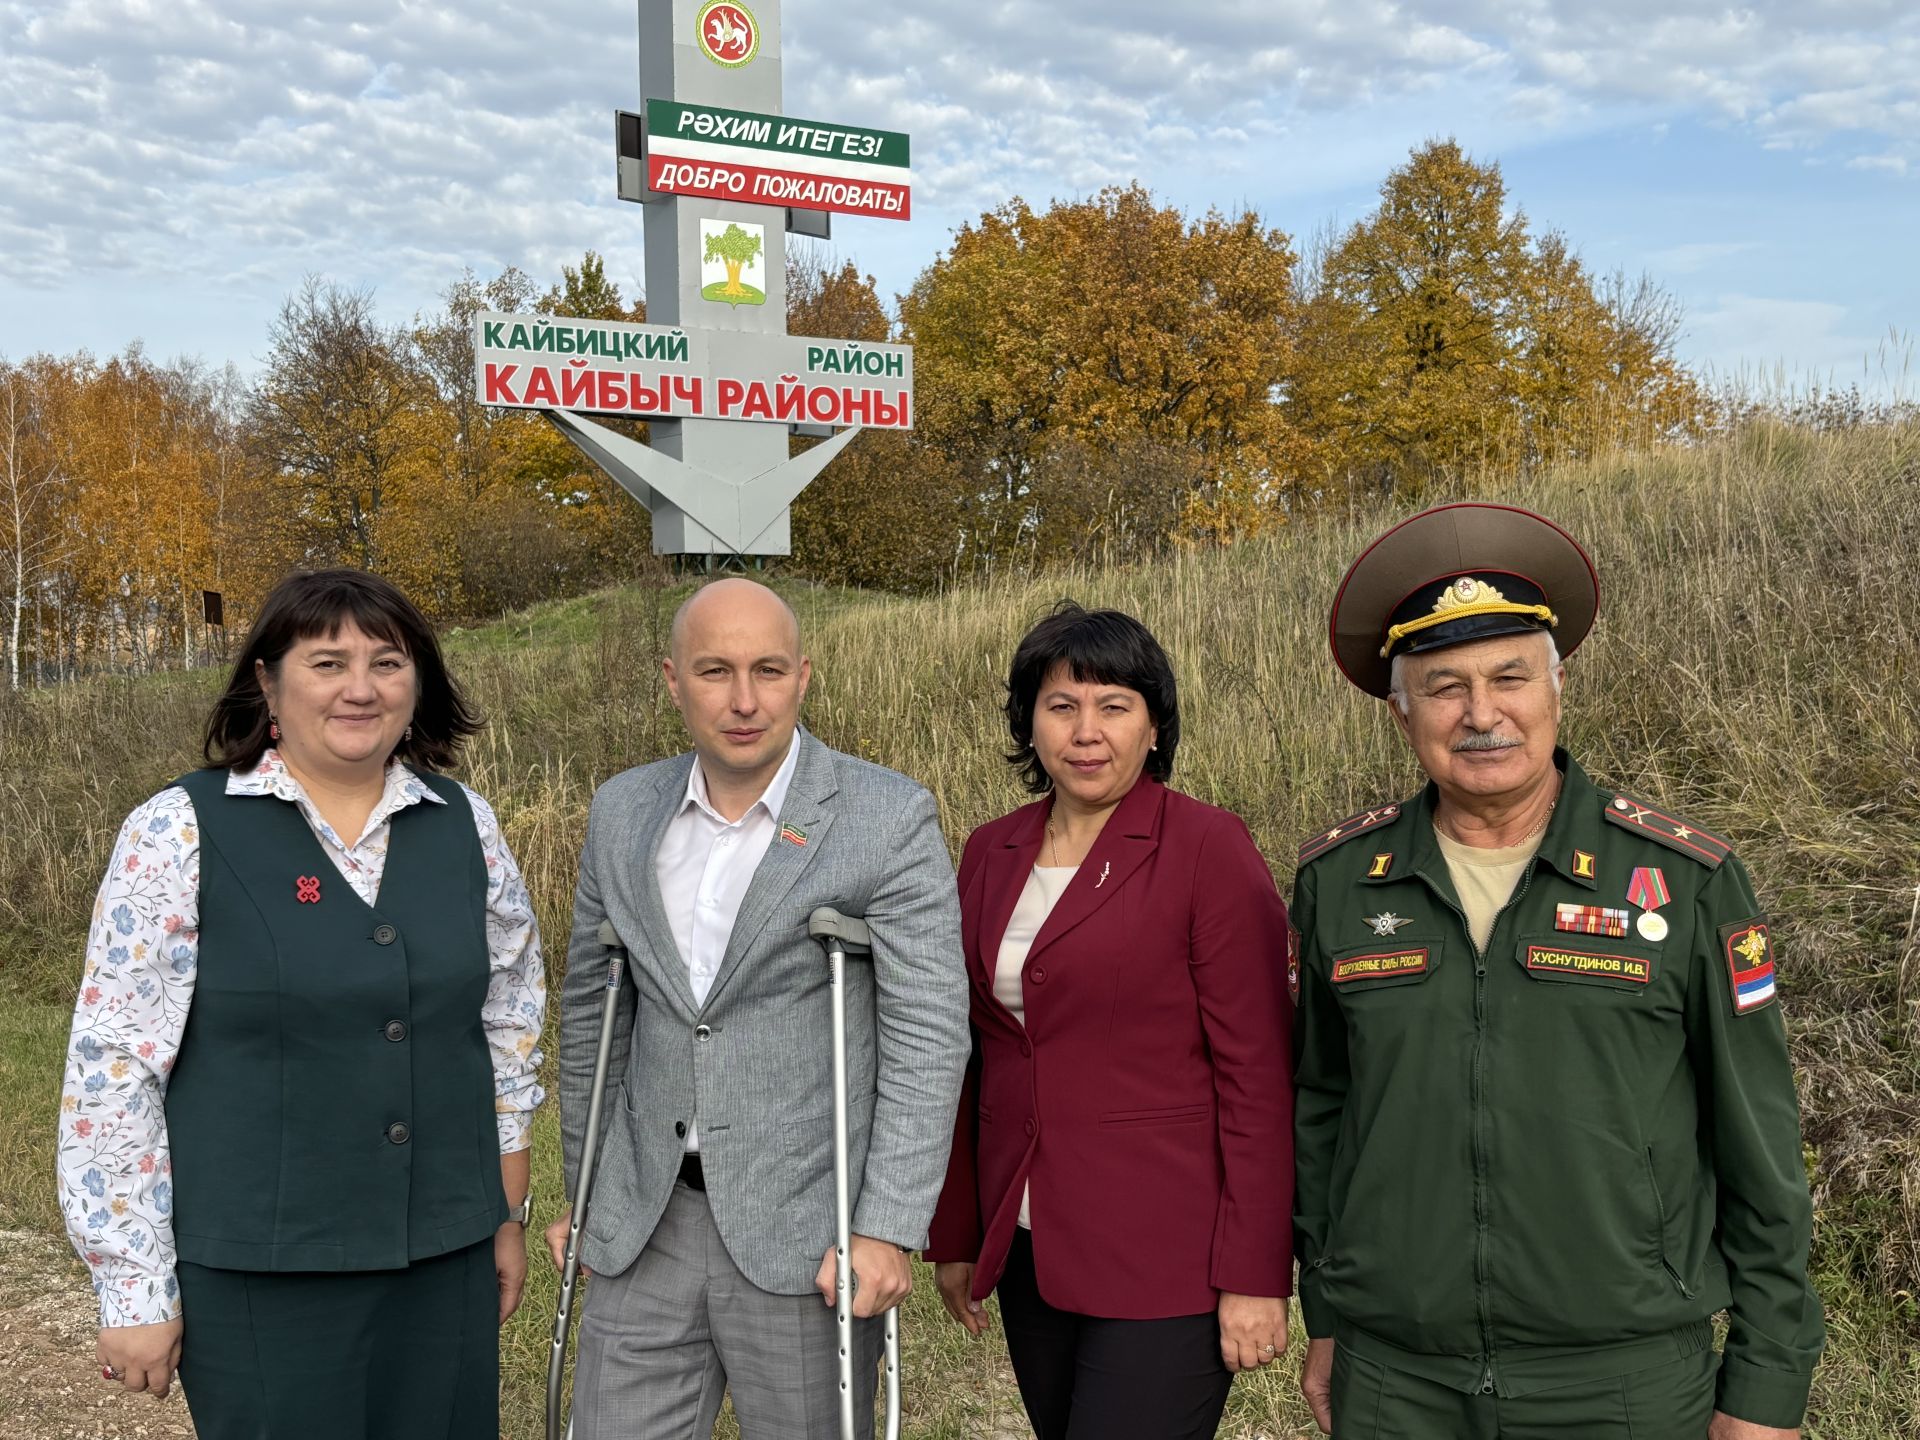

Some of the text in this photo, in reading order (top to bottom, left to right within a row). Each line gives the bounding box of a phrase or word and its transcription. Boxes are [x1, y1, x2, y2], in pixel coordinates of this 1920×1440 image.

[677, 110, 884, 157] РӘХИМ ИТЕГЕЗ!
[656, 163, 905, 212] ДОБРО ПОЖАЛОВАТЬ!
[483, 319, 904, 378] КАЙБИЦКИЙ РАЙОН
[485, 359, 909, 427] КАЙБЫЧ РАЙОНЫ
[1532, 951, 1645, 976] ХУСНУТДИНОВ И.В.
